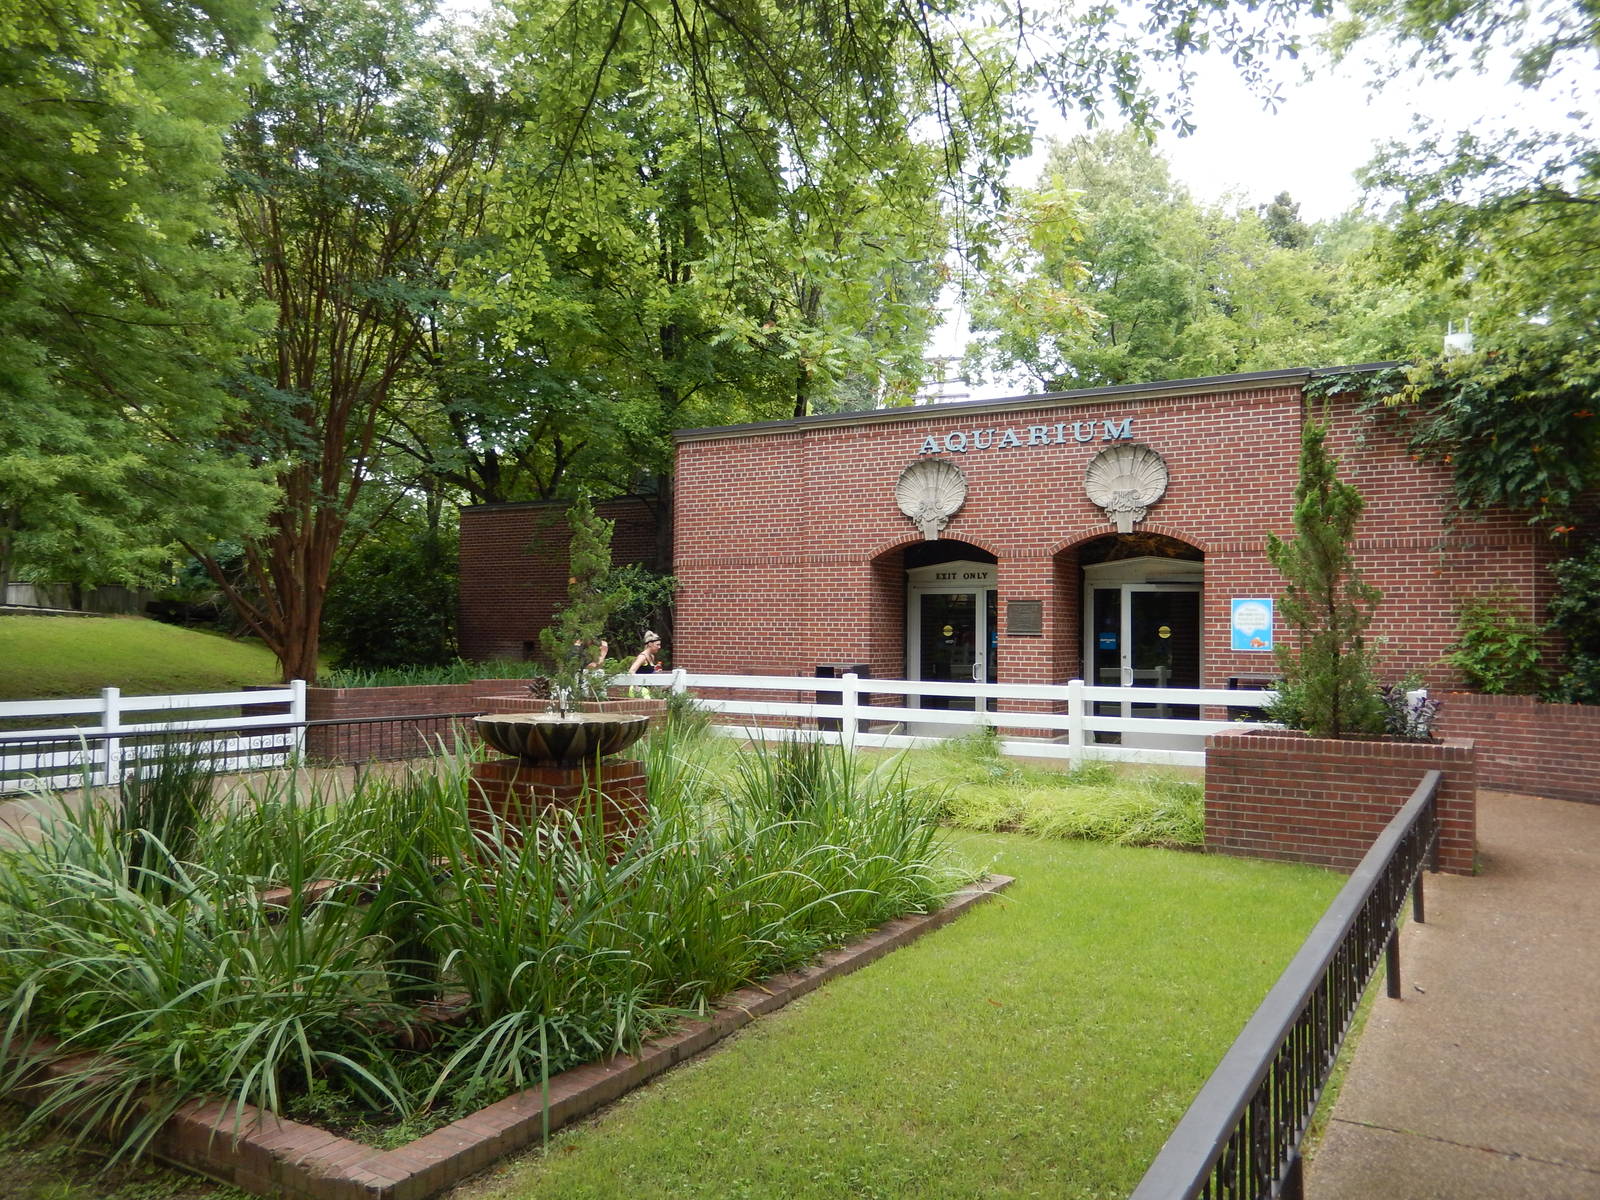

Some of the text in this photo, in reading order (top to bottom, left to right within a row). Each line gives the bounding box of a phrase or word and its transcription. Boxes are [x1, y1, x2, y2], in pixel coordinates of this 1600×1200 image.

[919, 418, 1134, 455] AQUARIUM
[935, 572, 988, 580] EXIT ONLY
